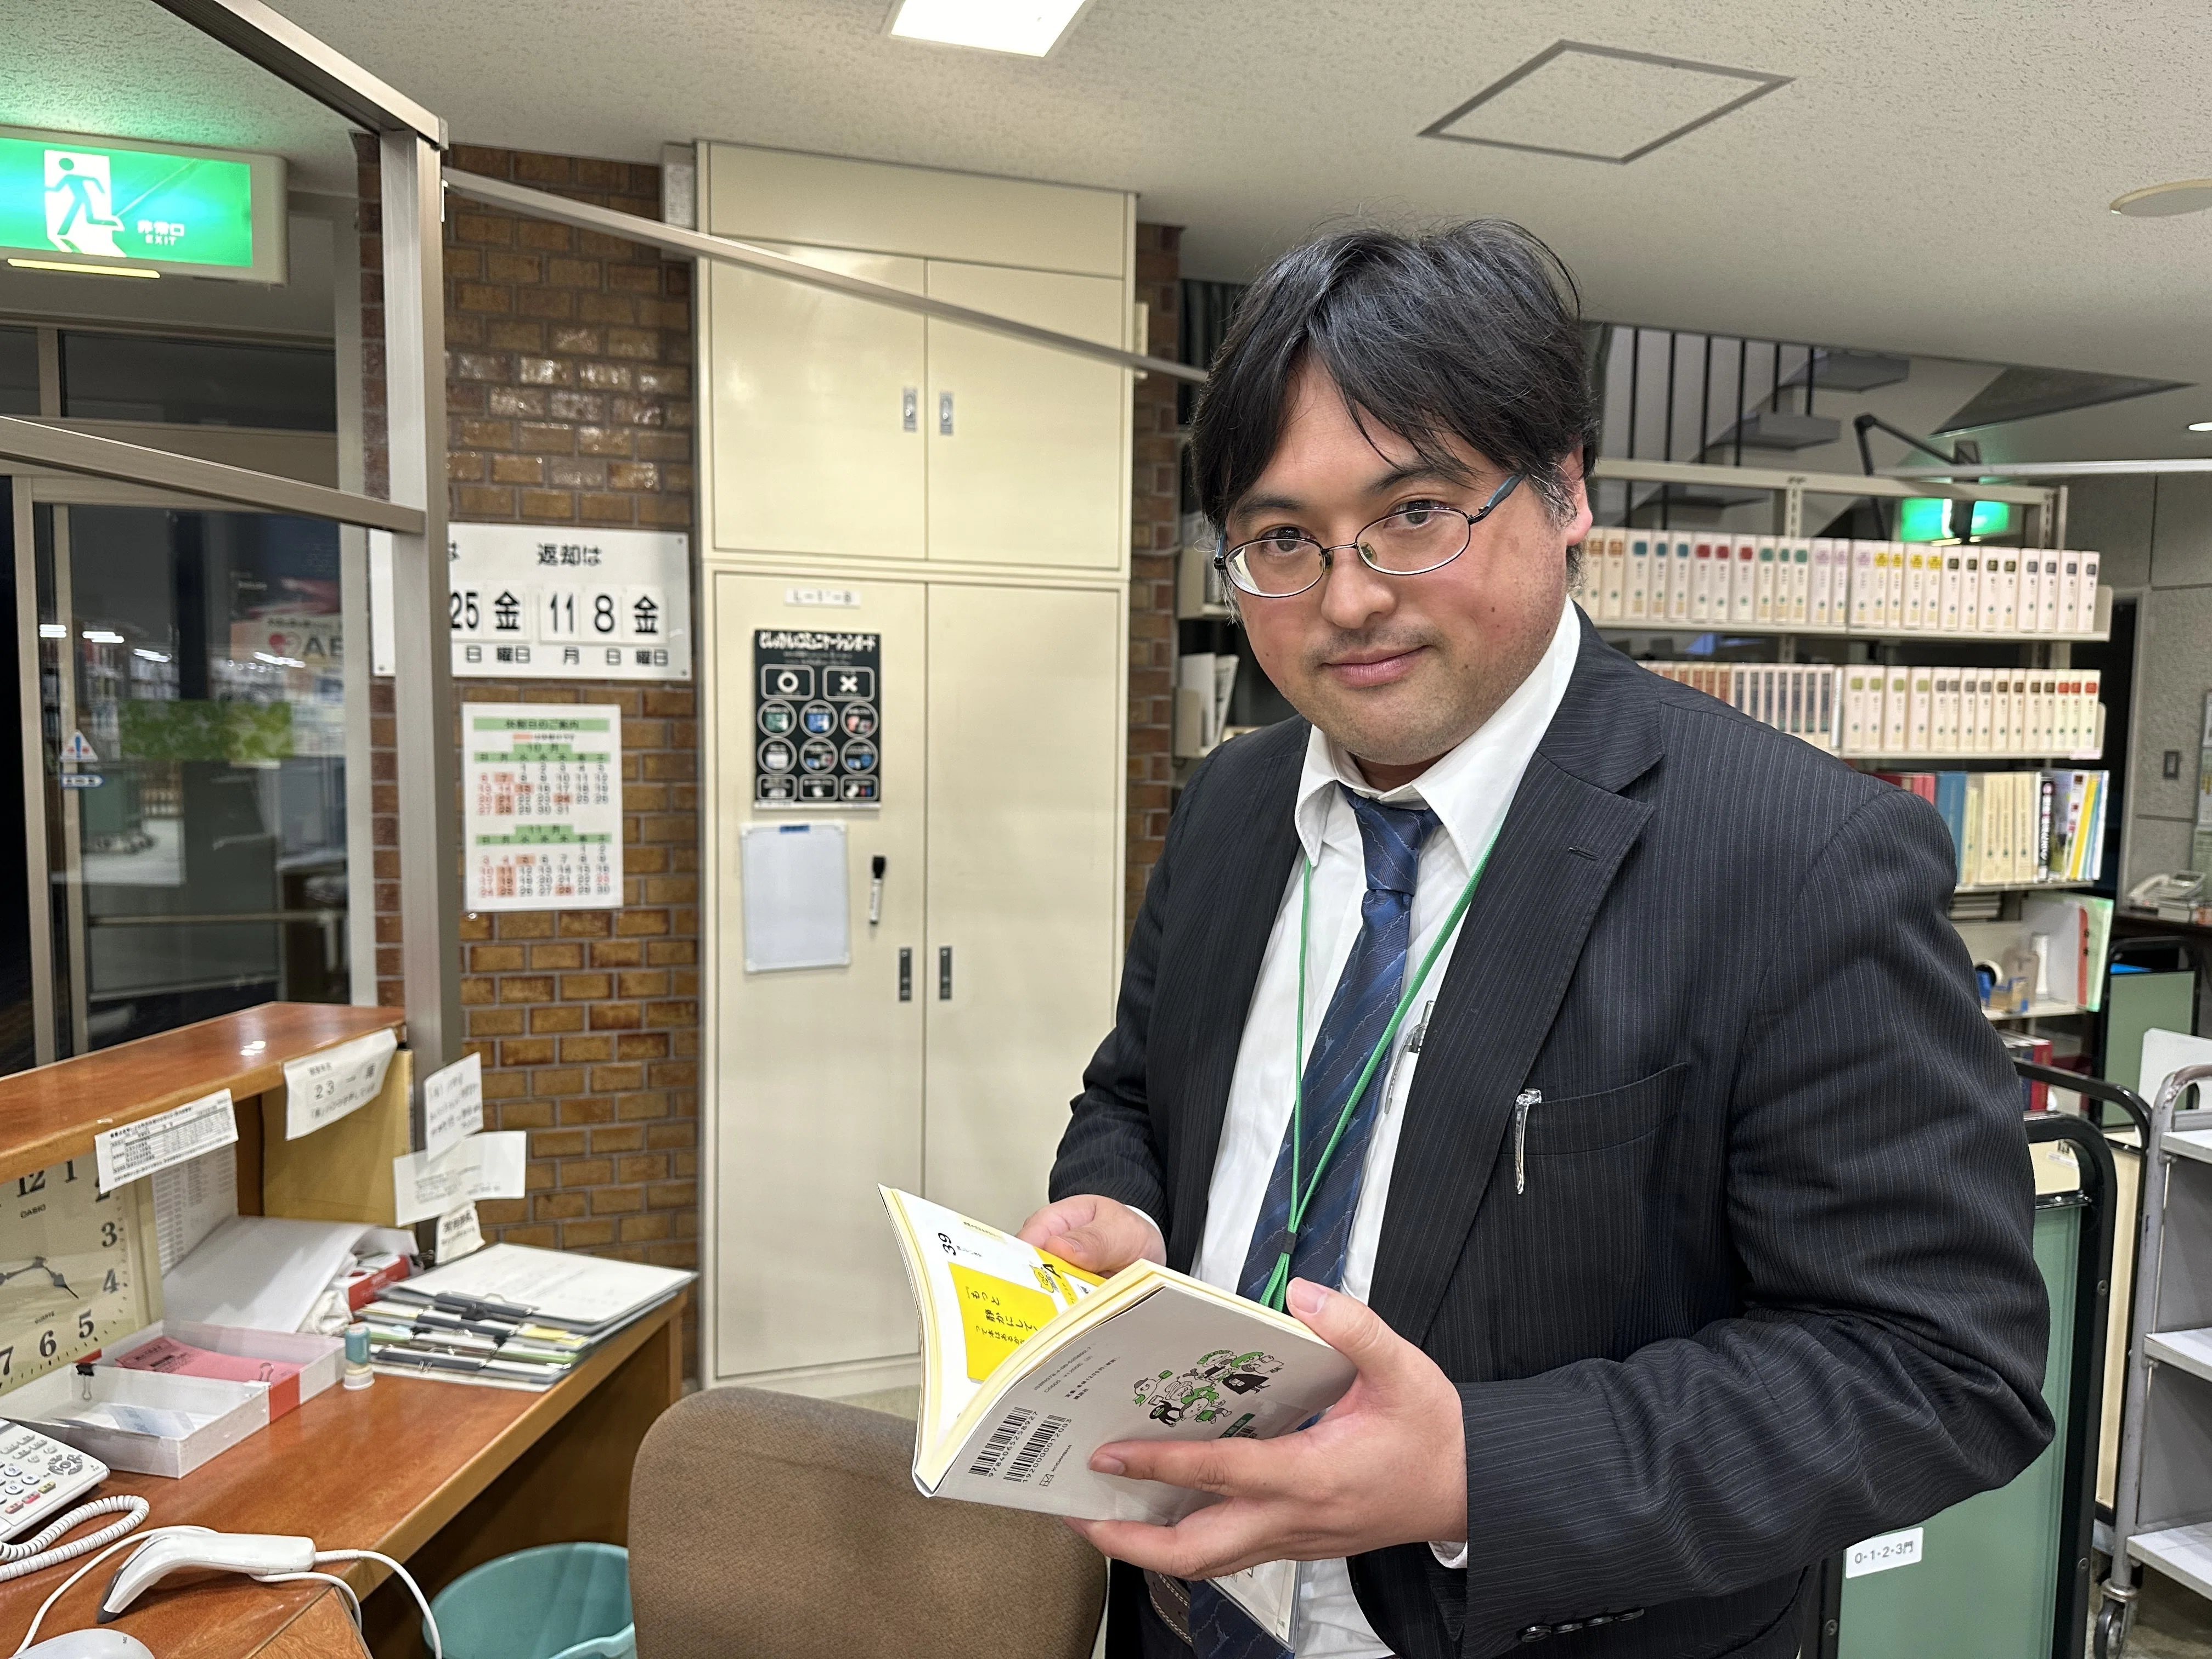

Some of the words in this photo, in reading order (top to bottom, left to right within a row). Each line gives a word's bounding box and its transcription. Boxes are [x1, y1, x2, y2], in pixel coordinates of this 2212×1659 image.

[145, 234, 177, 246] EXIT
[536, 543, 602, 567] 返却は
[494, 589, 520, 630] 金
[634, 595, 658, 634] 金
[65, 1159, 78, 1183] 1
[20, 1204, 46, 1219] CASIO
[101, 1222, 118, 1248] 3
[938, 1232, 957, 1256] 39
[103, 1268, 120, 1294] 4
[965, 1285, 1000, 1306] 「もっと
[78, 1309, 94, 1339] 5
[39, 1330, 57, 1357] 6
[0, 1346, 14, 1376] 7
[988, 1411, 1038, 1477] 9784065258927
[1023, 1419, 1072, 1483] 1920000012003
[1051, 1444, 1073, 1472] KODANSHA
